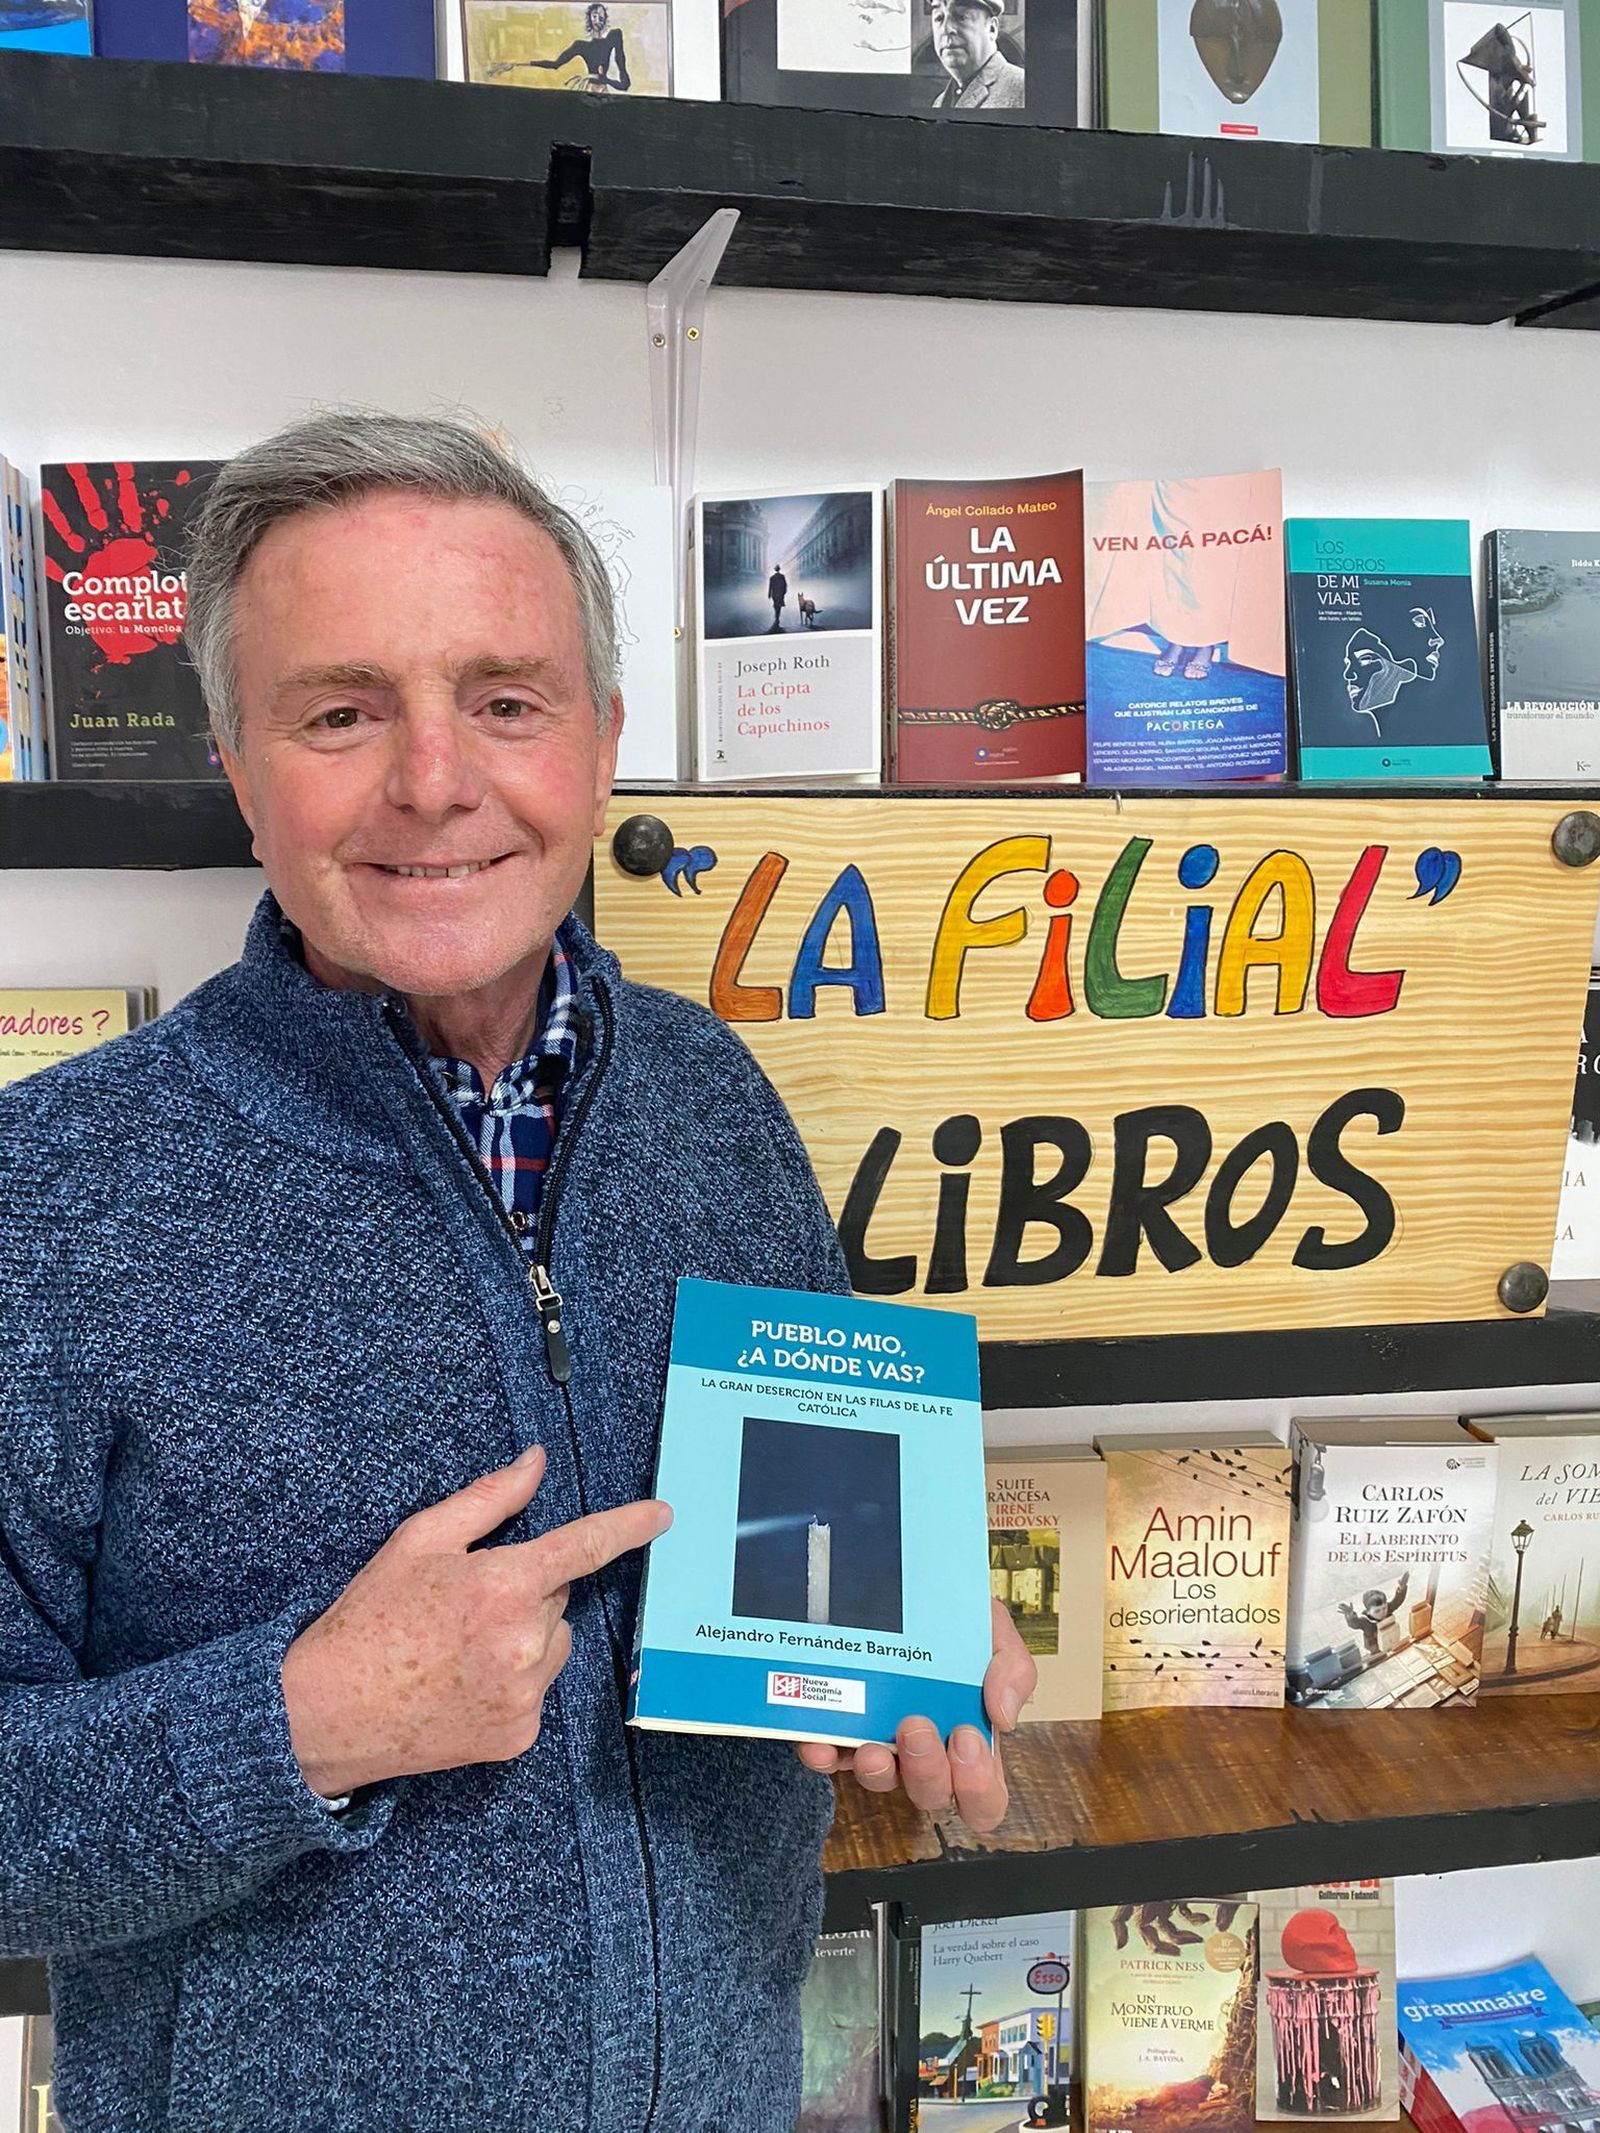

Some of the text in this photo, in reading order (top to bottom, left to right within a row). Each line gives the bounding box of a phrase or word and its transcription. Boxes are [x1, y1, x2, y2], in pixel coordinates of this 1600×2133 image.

[926, 501, 1057, 518] Ángel Collado Mateo
[970, 526, 1016, 554] LA
[1092, 525, 1272, 551] VEN ACÁ PACÁ!
[1315, 540, 1344, 554] LOS
[925, 555, 1062, 590] ÚLTIMA
[1314, 558, 1385, 572] TESOROS
[62, 571, 187, 602] Complot
[1317, 575, 1359, 589] DE MI
[1317, 592, 1360, 605] VIAJE
[64, 596, 187, 622] escarlat
[955, 596, 1030, 625] VEZ
[65, 623, 182, 637] Objetivo: la Moncloa
[734, 655, 830, 678] Joseph Roth
[737, 682, 810, 699] La Cripta
[737, 702, 781, 716] de los
[1128, 697, 1243, 710] CATORCE RELATOS BREVES
[1506, 701, 1521, 711] LA
[1524, 699, 1595, 711] REVOLUCIÓN
[1114, 710, 1132, 718] QUE
[1133, 709, 1174, 717] ILUSTRAN
[1175, 707, 1192, 715] LAS
[1194, 705, 1244, 715] CANCIONES
[1565, 711, 1594, 719] mundo
[70, 712, 175, 728] Juan Rada
[1146, 720, 1224, 731] PACORTEGA
[737, 719, 830, 738] Capuchinos
[751, 1320, 907, 1358] PUEBLO MIO,
[737, 1348, 926, 1385] ¿A DÓNDE VAS?
[701, 1378, 953, 1417] LA GRAN DESERCIÓN EN LAS FILAS DE LA FE
[797, 1402, 858, 1419] CATÓLICA
[1519, 1464, 1551, 1482] LA
[996, 1479, 1035, 1491] SUITE
[987, 1491, 1051, 1503] RANCESA
[1362, 1484, 1444, 1502] CARLOS
[1535, 1492, 1558, 1506] del
[989, 1514, 1061, 1528] MIROVSKY
[1335, 1504, 1467, 1524] RUIZ ZAFÓN
[1543, 1513, 1583, 1521] CARLOS
[1143, 1506, 1252, 1542] Amin
[1339, 1532, 1459, 1546] EL LABERINTO
[1110, 1542, 1282, 1580] Maalouf
[1328, 1549, 1468, 1564] DE LOS ESPÍRITUS
[1173, 1580, 1216, 1600] Los
[1109, 1603, 1281, 1628] desorientados
[695, 1624, 933, 1663] Alejandro Fernández Barrajón
[802, 1677, 828, 1687] Nueva
[802, 1685, 842, 1696] Economía
[802, 1693, 827, 1702] Social
[933, 1937, 1039, 1954] La verdad sobre el caso
[933, 1952, 1003, 1967] Harry Quebert
[1120, 1960, 1206, 1972] PATRICK NESS
[1136, 1994, 1156, 2004] UN
[1403, 1988, 1548, 2022] grammaire
[1111, 2002, 1193, 2017] MONSTRUO
[1122, 2017, 1158, 2029] VIENE
[1171, 2018, 1215, 2032] VERME
